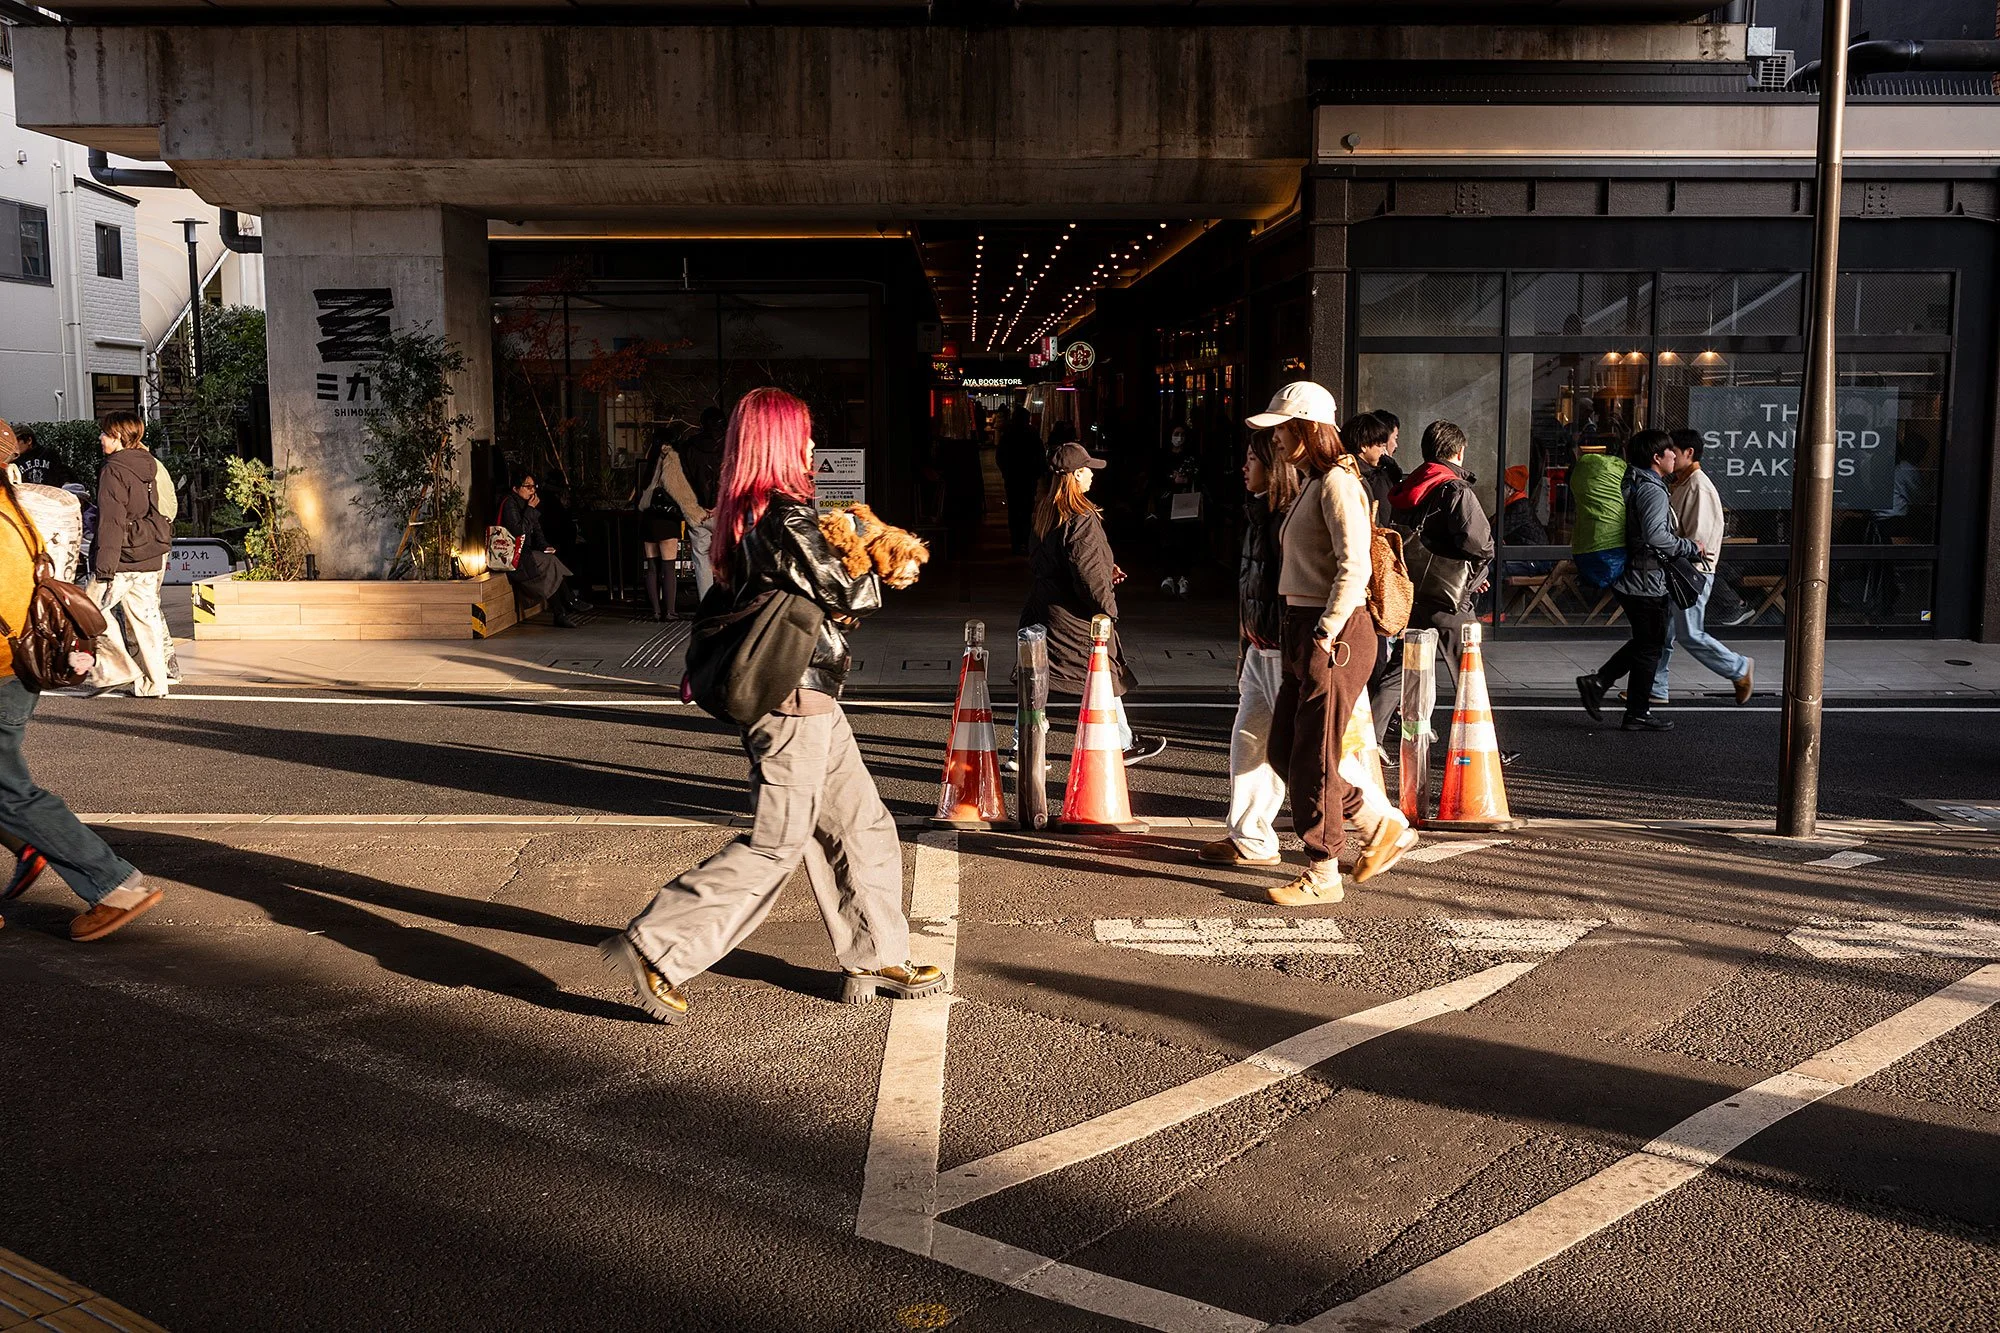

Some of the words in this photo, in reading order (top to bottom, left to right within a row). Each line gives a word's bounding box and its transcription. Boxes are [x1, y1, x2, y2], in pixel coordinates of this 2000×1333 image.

[1760, 403, 1799, 422] TH
[1703, 430, 1880, 449] STANRD
[1726, 458, 1855, 477] BAKS
